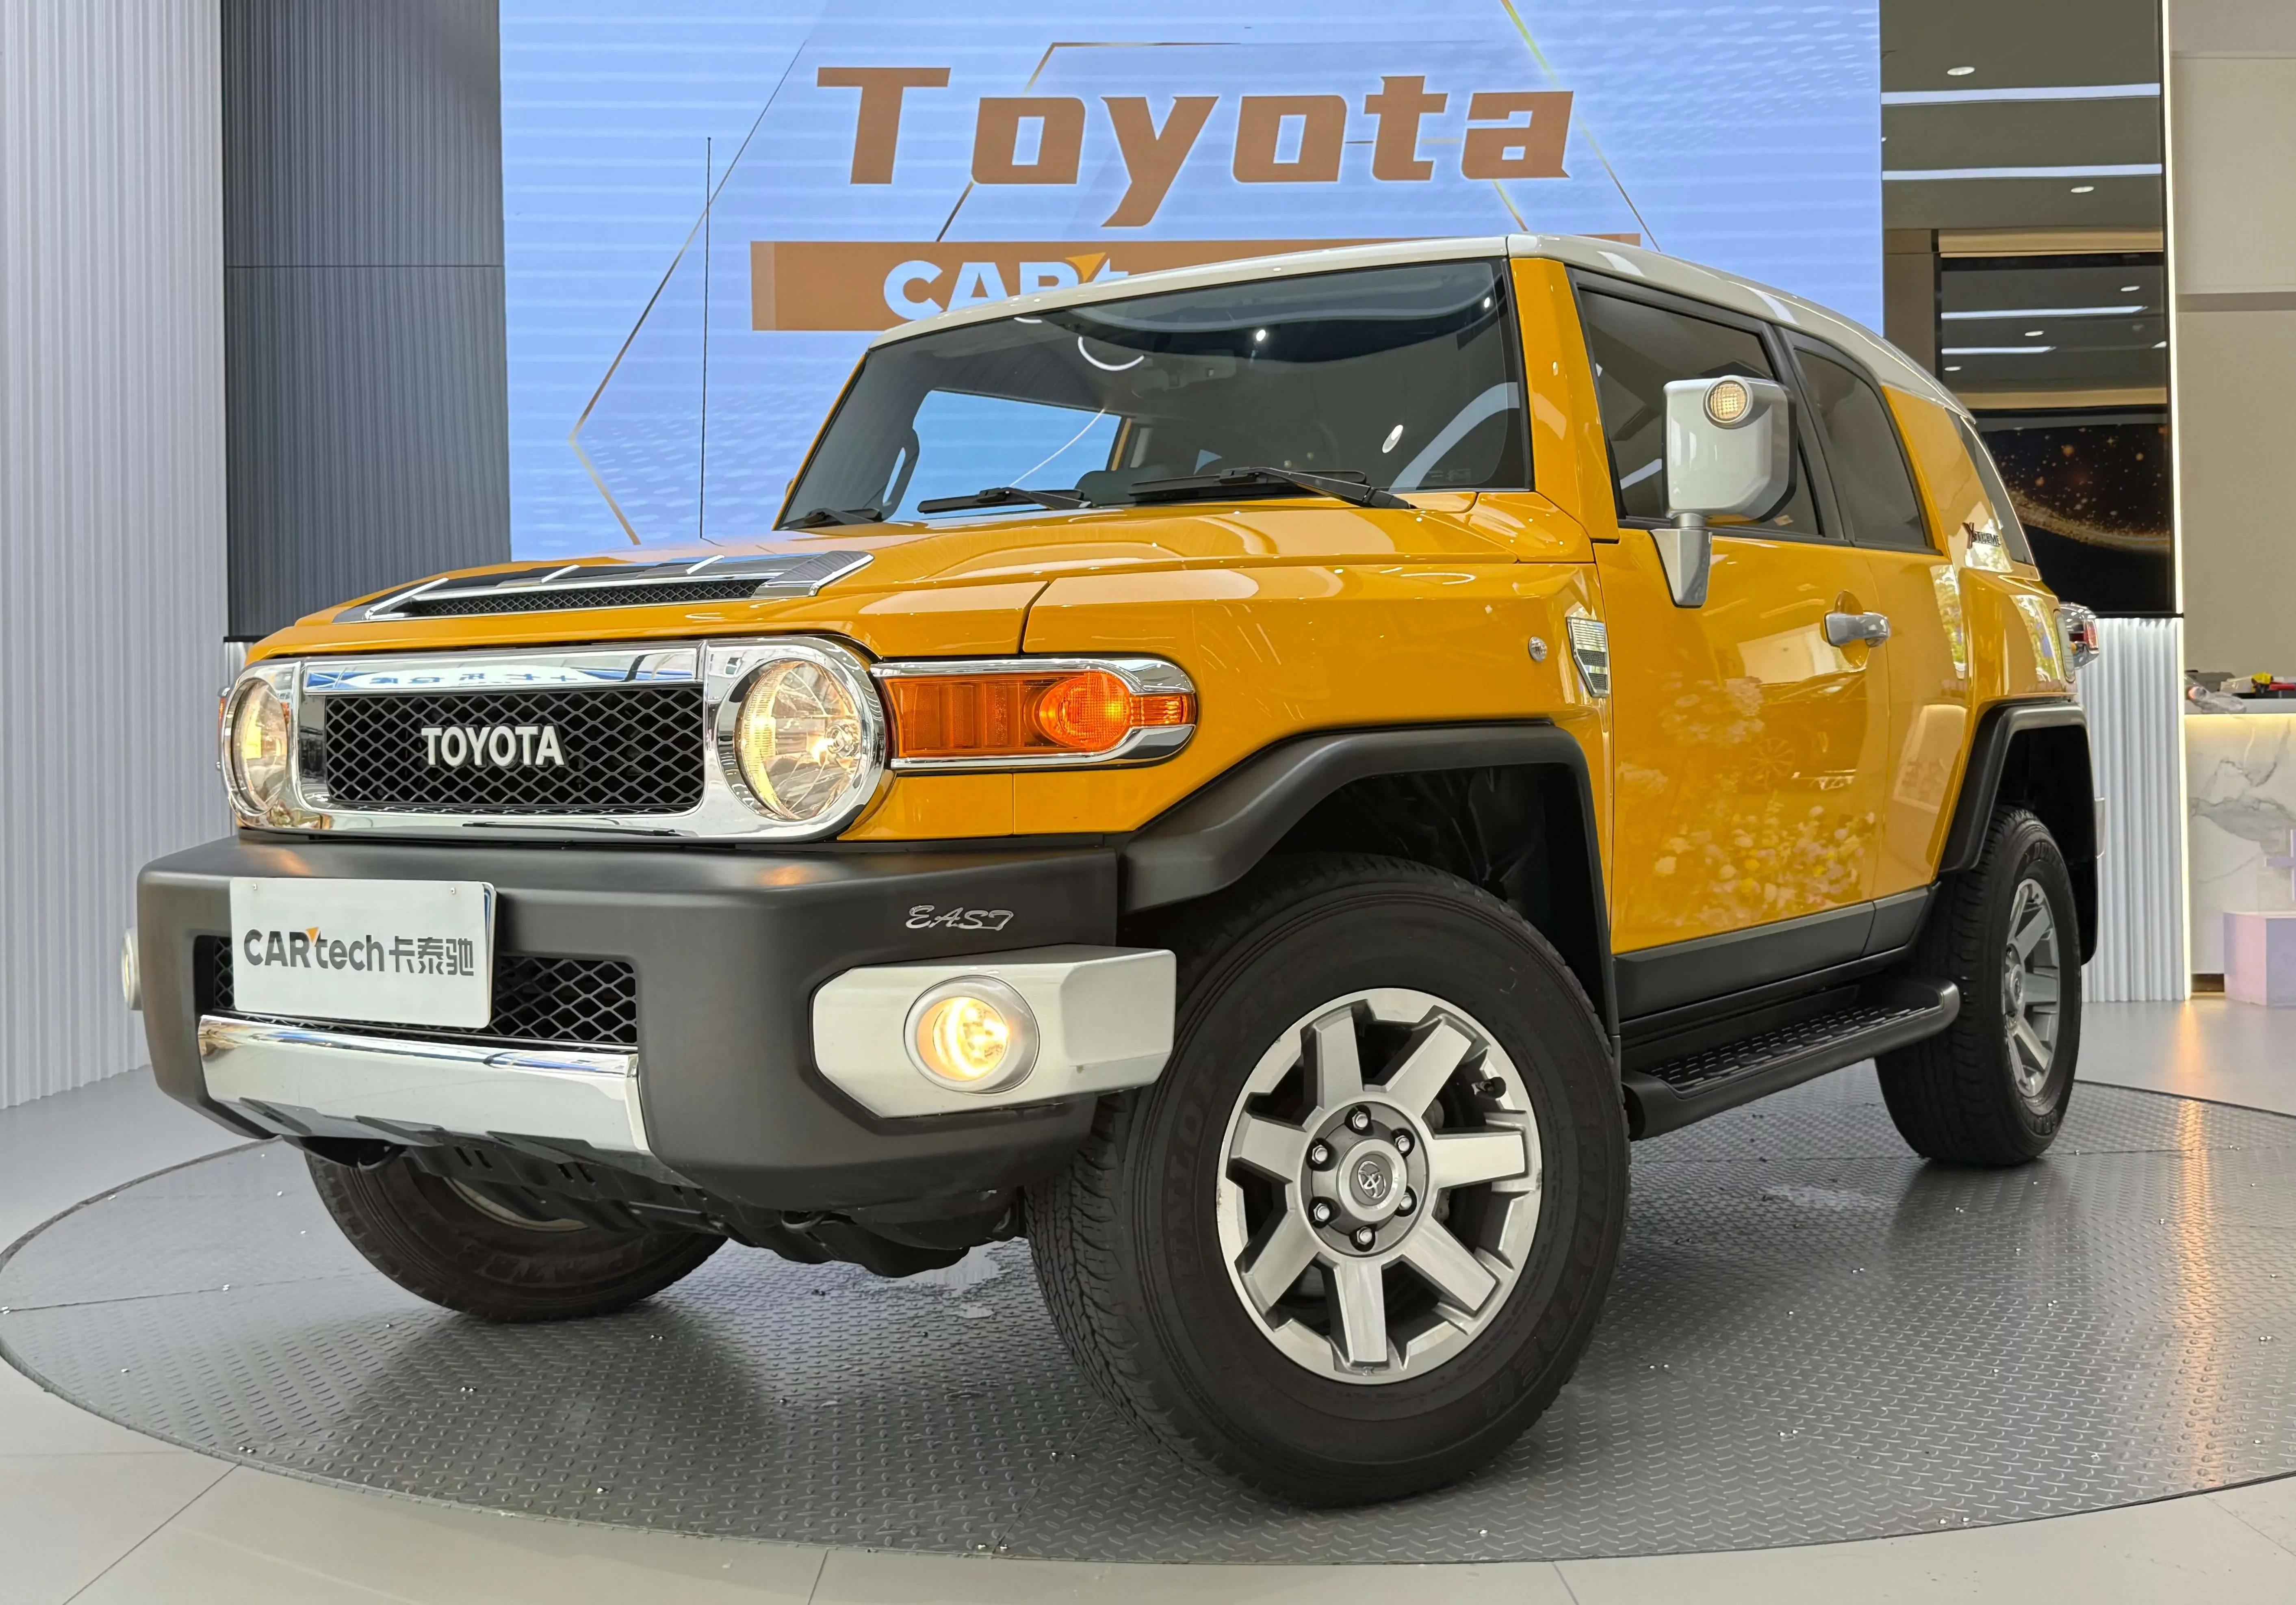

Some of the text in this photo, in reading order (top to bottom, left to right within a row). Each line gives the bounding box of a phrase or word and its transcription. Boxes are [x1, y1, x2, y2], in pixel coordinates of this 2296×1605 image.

[817, 67, 1574, 227] Toyota
[421, 725, 565, 767] TOYOTA
[906, 905, 1014, 931] EAST
[244, 927, 474, 976] CARtech 卡泰驰
